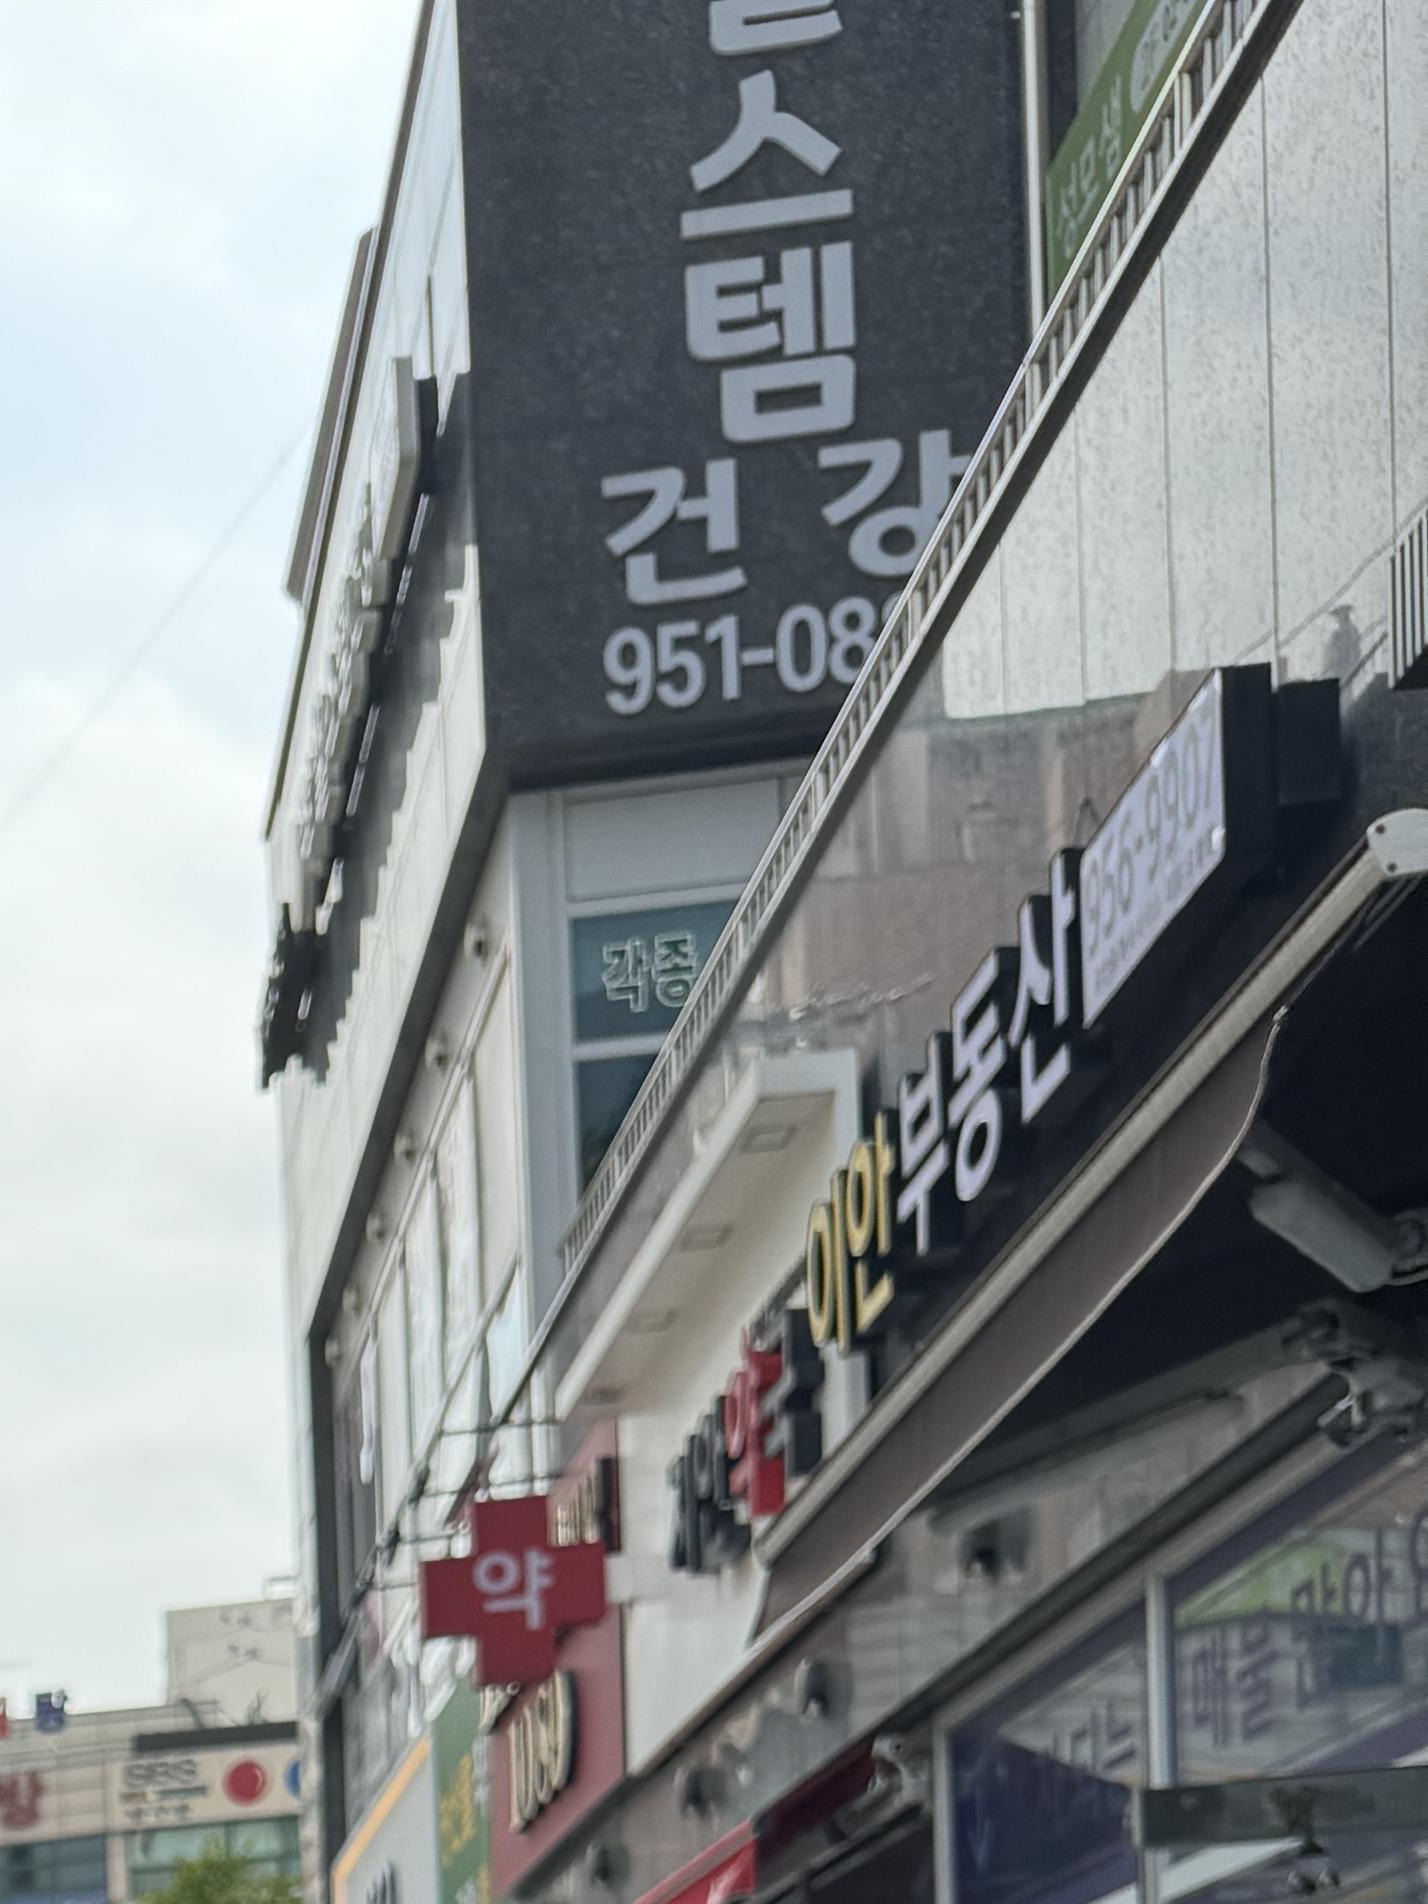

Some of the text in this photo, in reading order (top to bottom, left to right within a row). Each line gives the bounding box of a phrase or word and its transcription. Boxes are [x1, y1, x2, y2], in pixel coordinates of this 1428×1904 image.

[602, 591, 904, 715] 951-08
[1086, 687, 1217, 960] 956-9907
[473, 1550, 556, 1631] 약
